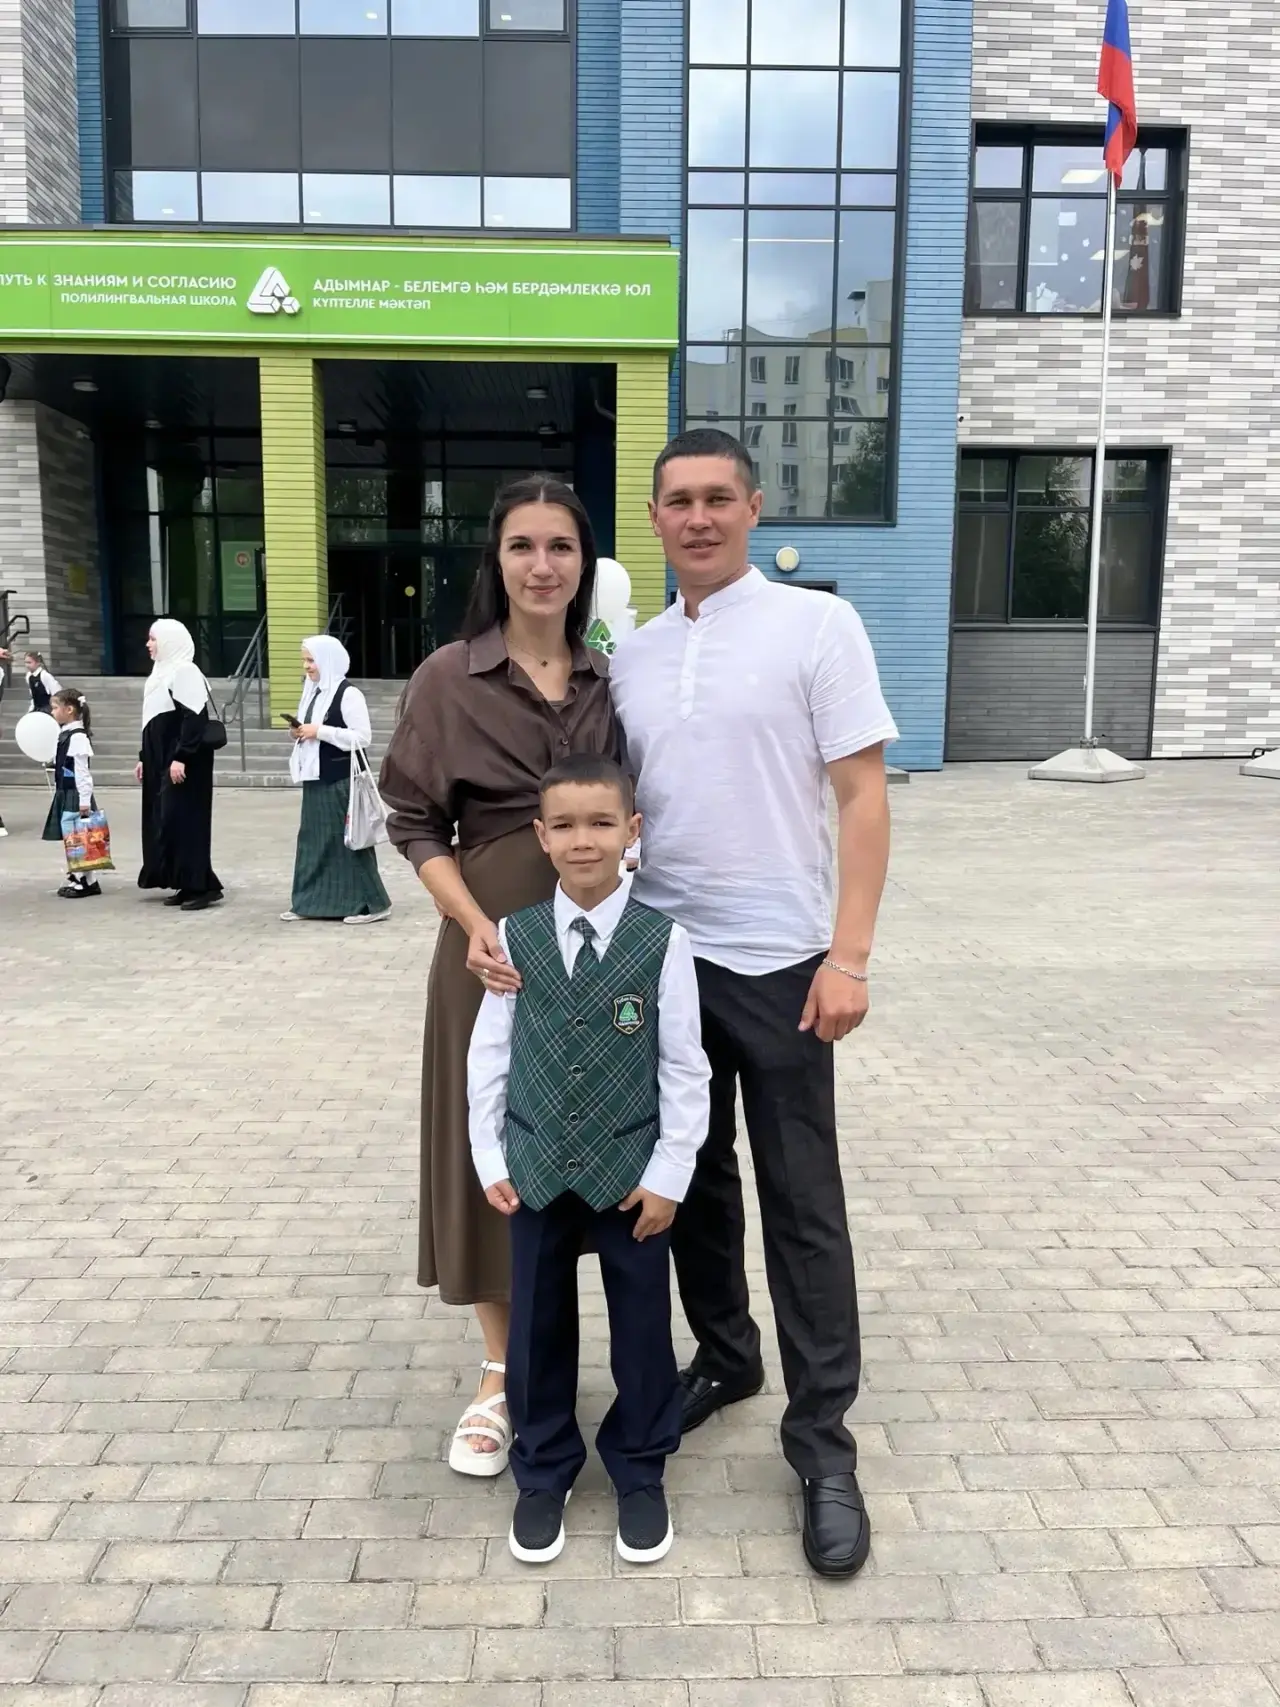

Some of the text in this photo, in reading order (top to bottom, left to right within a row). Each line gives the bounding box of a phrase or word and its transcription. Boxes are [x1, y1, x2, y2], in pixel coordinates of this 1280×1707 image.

[36, 273, 48, 286] К
[53, 274, 128, 288] ЗНАНИЯМ
[132, 275, 143, 288] И
[147, 276, 237, 290] СОГЛАСИЮ
[312, 279, 391, 293] АДЫМНАР
[403, 280, 472, 294] БЕЛЕМГӘ
[512, 282, 621, 297] БЕРДӘМЛЕККӘ
[625, 283, 651, 296] ЮЛ
[61, 292, 237, 307] ПОЛИЛИНГВАЛЬНАЯ ШКОЛА
[379, 298, 431, 310] МӘКТӘП
